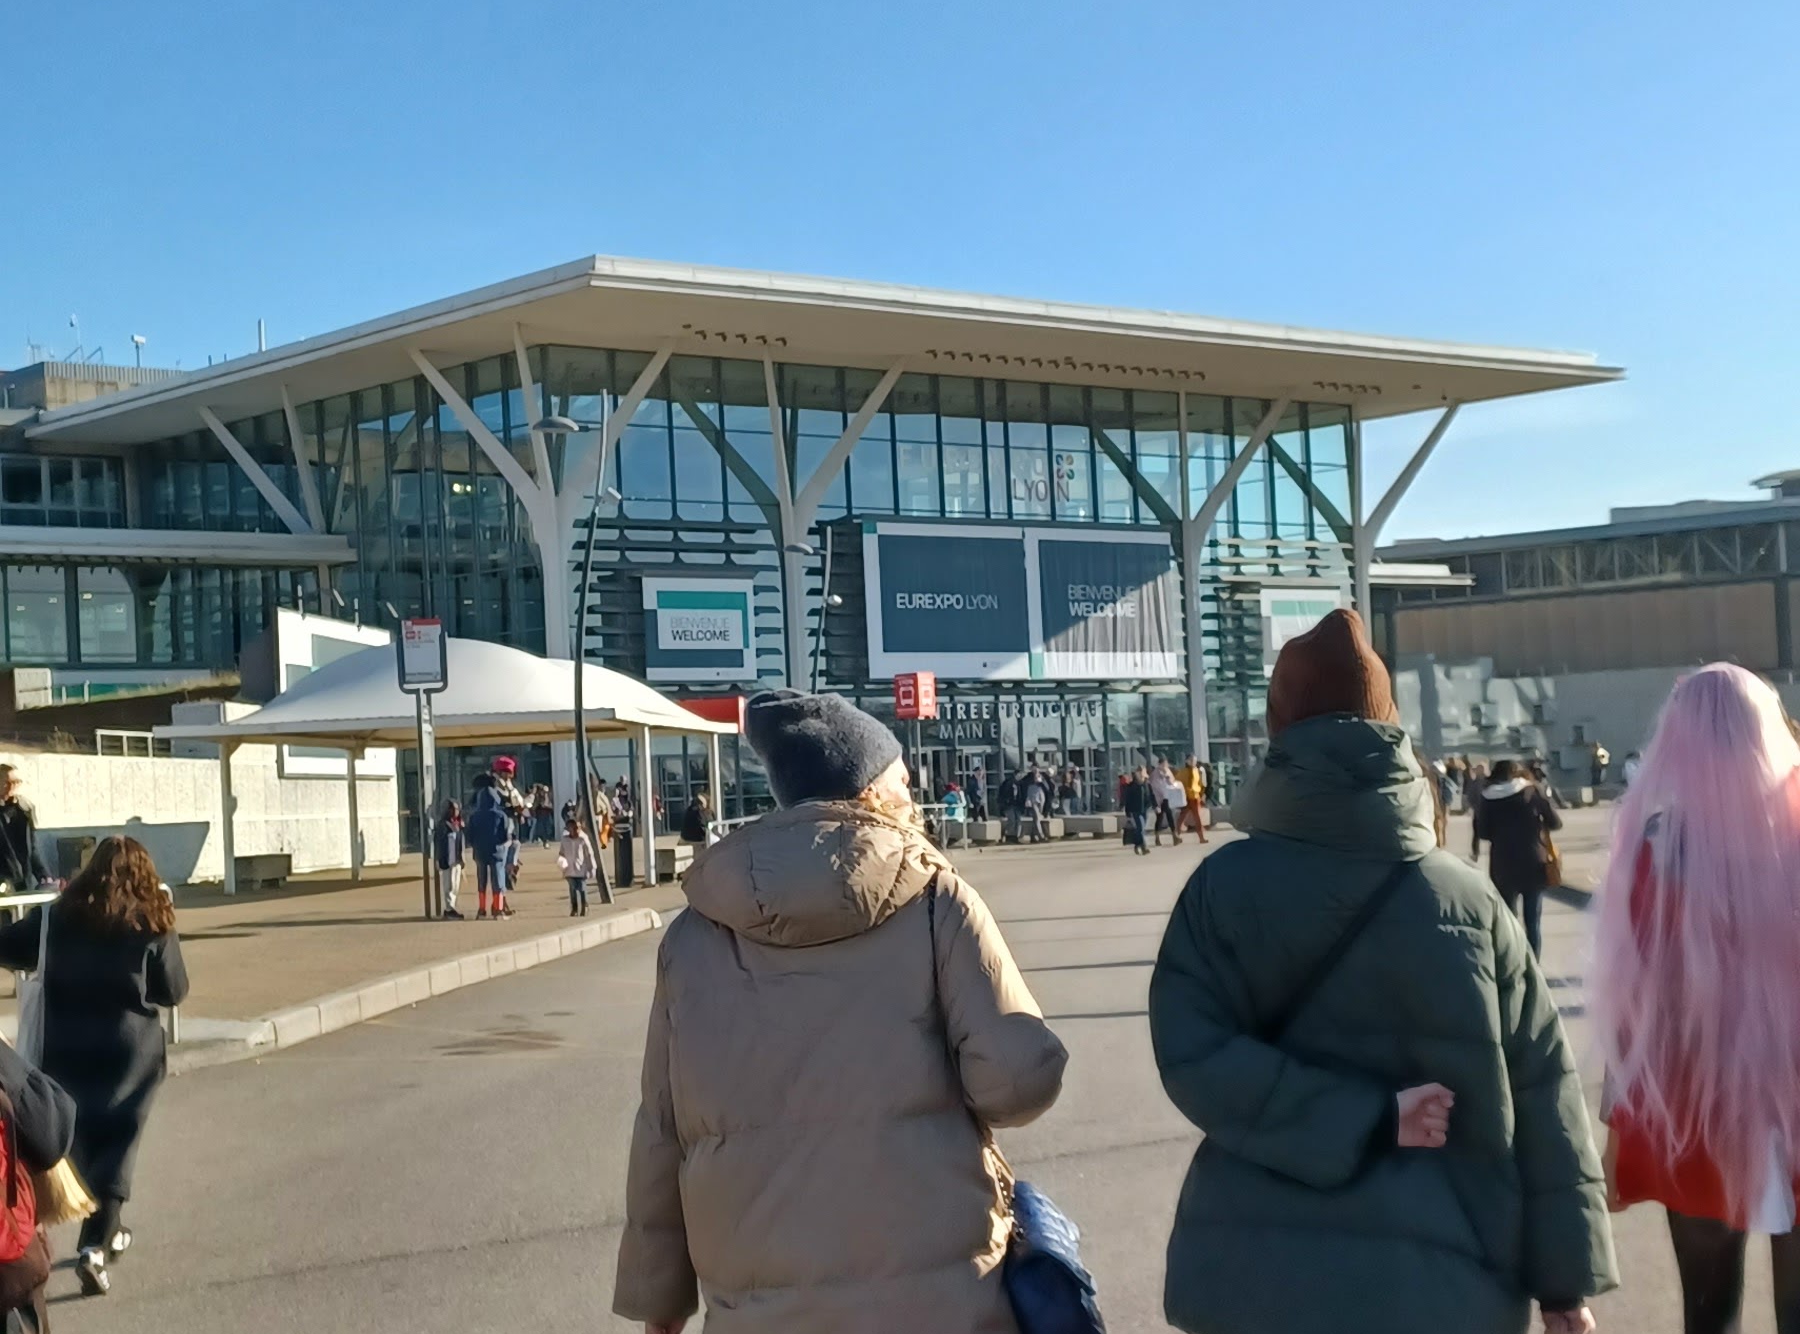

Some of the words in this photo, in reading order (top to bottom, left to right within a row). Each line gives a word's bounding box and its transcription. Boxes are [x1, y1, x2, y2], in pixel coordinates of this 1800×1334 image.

[1012, 477, 1071, 503] LYON
[896, 593, 964, 609] EUREXPO
[965, 594, 998, 609] LYON
[1068, 601, 1136, 618] WELCOME
[670, 616, 730, 629] BIENVENUE
[671, 630, 730, 642] WELCOME
[917, 703, 991, 720] TREE
[939, 722, 983, 739] MAIN
